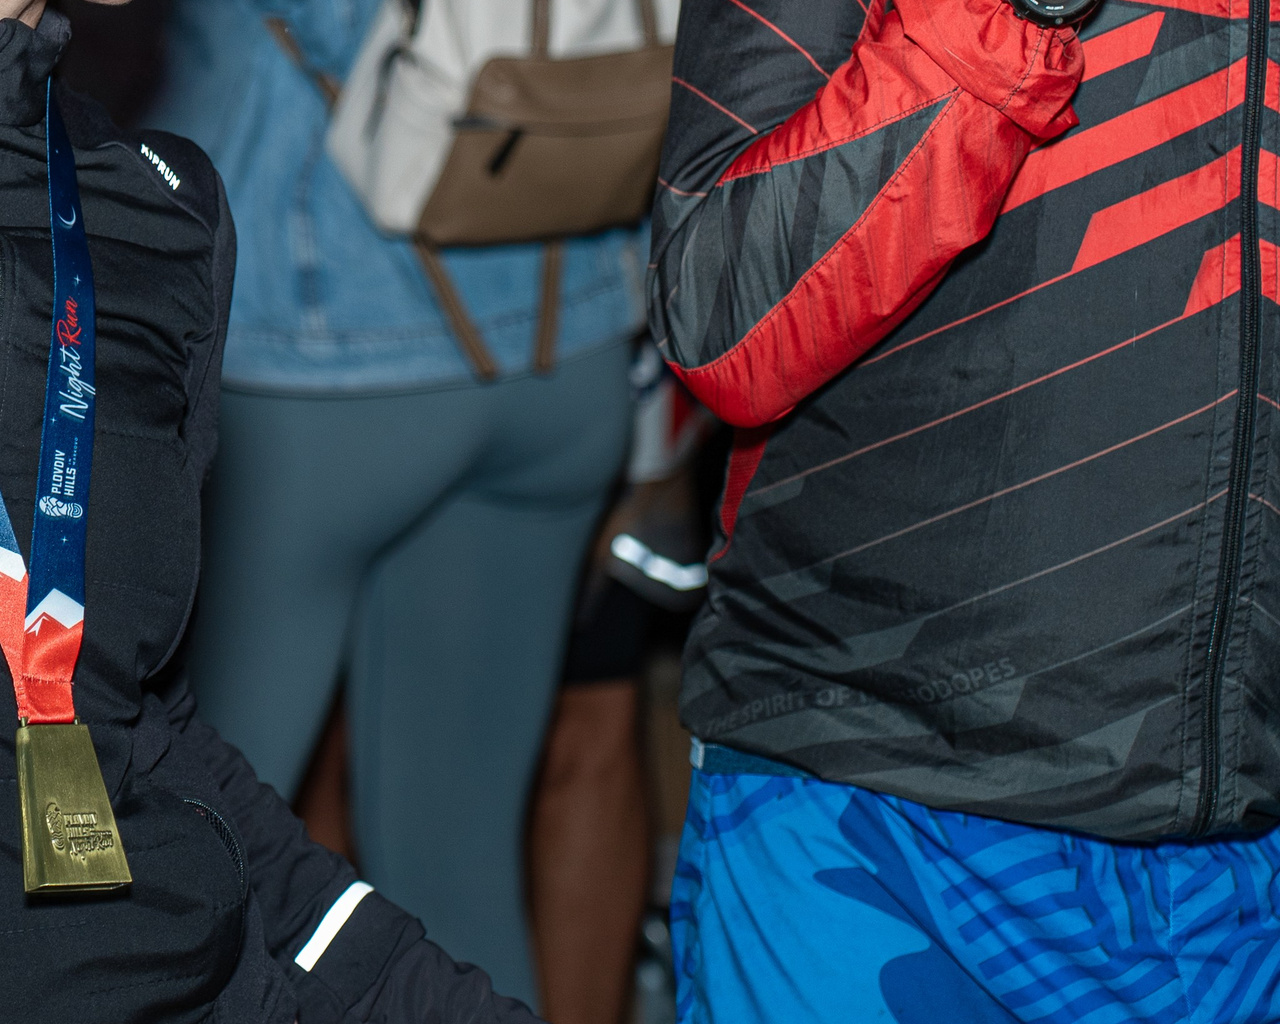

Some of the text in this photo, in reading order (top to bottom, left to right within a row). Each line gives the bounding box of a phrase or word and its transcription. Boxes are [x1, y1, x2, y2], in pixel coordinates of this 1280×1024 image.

[141, 143, 181, 191] KIPRUN
[56, 295, 96, 420] Night Run
[51, 449, 66, 494] PLOVDIV
[64, 467, 77, 497] HILLS
